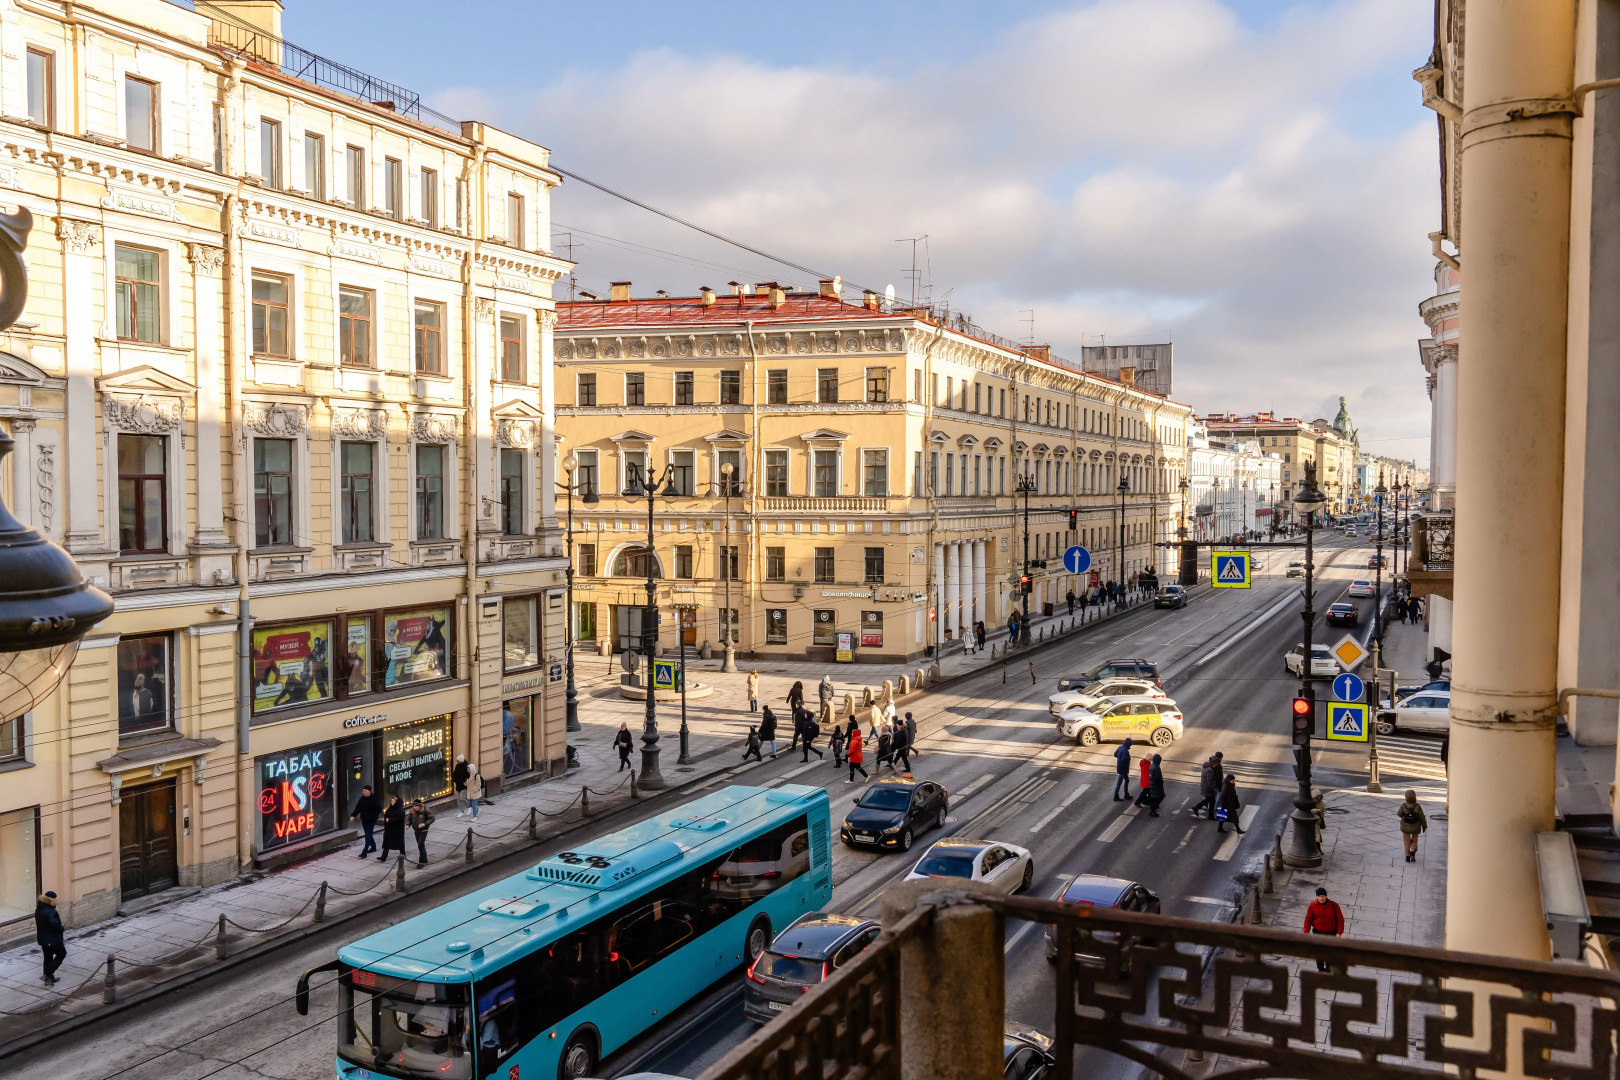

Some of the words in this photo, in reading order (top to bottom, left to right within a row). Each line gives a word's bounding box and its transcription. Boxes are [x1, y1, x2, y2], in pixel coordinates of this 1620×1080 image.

[406, 624, 422, 633] МУЗЕЙ
[279, 641, 299, 650] МУЗЕЙ
[344, 715, 367, 728] cofix
[386, 728, 443, 757] КОФЕЙНЯ
[265, 750, 323, 778] ТАБАК
[389, 758, 415, 773] СВЕЖАЯ
[415, 750, 443, 766] ВЫПЕЧКА
[389, 775, 395, 784] И
[395, 769, 413, 782] КОФЕ
[311, 780, 323, 793] 24
[261, 794, 275, 808] 24
[282, 776, 307, 816] KS
[275, 812, 315, 838] VAPE
